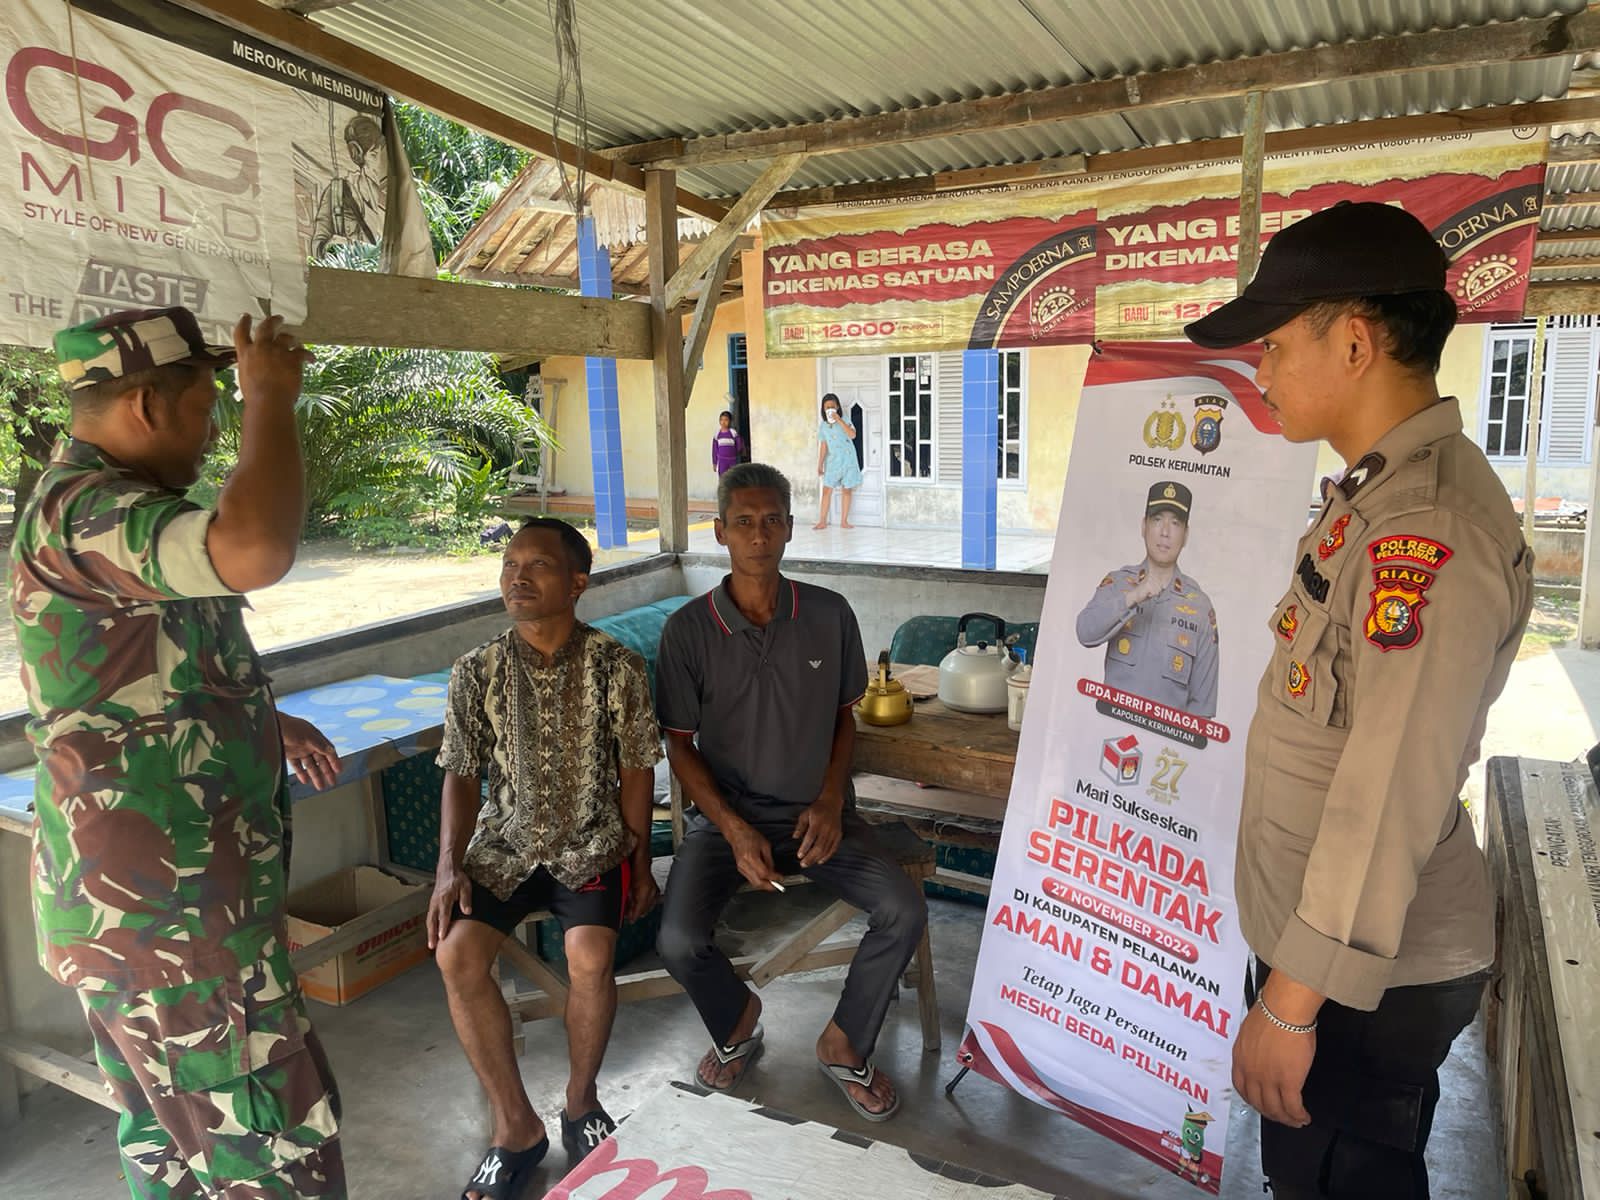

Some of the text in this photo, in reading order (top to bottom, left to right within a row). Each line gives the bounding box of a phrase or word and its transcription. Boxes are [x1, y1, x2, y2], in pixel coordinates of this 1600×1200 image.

[232, 40, 308, 81] MEROKOK
[5, 46, 261, 199] GG
[21, 152, 261, 242] MILD
[23, 202, 266, 267] STYLE OF NEW GENERATION
[1105, 218, 1218, 246] YANG
[768, 239, 994, 274] YANG BERASA
[91, 261, 200, 309] TASTE
[767, 265, 995, 296] DIKEMAS SATUAN
[987, 241, 1075, 320] SAMPOERNA
[1466, 288, 1502, 312] SIGARET
[1471, 266, 1508, 295] 234
[9, 292, 63, 320] THE
[1040, 297, 1069, 320] 234
[1124, 305, 1149, 322] BARU
[1129, 454, 1231, 478] POLSEK KERUMUTAN
[1376, 548, 1439, 565] PELALAWAN
[1380, 539, 1438, 556] POLRES
[1380, 569, 1426, 583] RIAU
[1171, 616, 1198, 633] POLRI
[1085, 682, 1224, 739] IPDA JERRI P SINAGA, SH
[1111, 706, 1195, 743] KAPOLSEK KERUMUTAN
[1151, 755, 1188, 793] 27
[1076, 779, 1109, 804] Mari
[1112, 794, 1199, 842] Sukseskan
[1049, 799, 1210, 897] PILKADA
[1027, 831, 1224, 944] SERENTAK
[1050, 882, 1193, 959] 27 NOVEMBER 2024
[1013, 889, 1220, 996] DI KABUPATEN PELALAWAN
[992, 904, 1232, 1039] AMAN & DAMAI
[1022, 965, 1189, 1061] Tetap Jaga Persatuan
[1000, 984, 1209, 1104] MESKI BEDA PILIHAN
